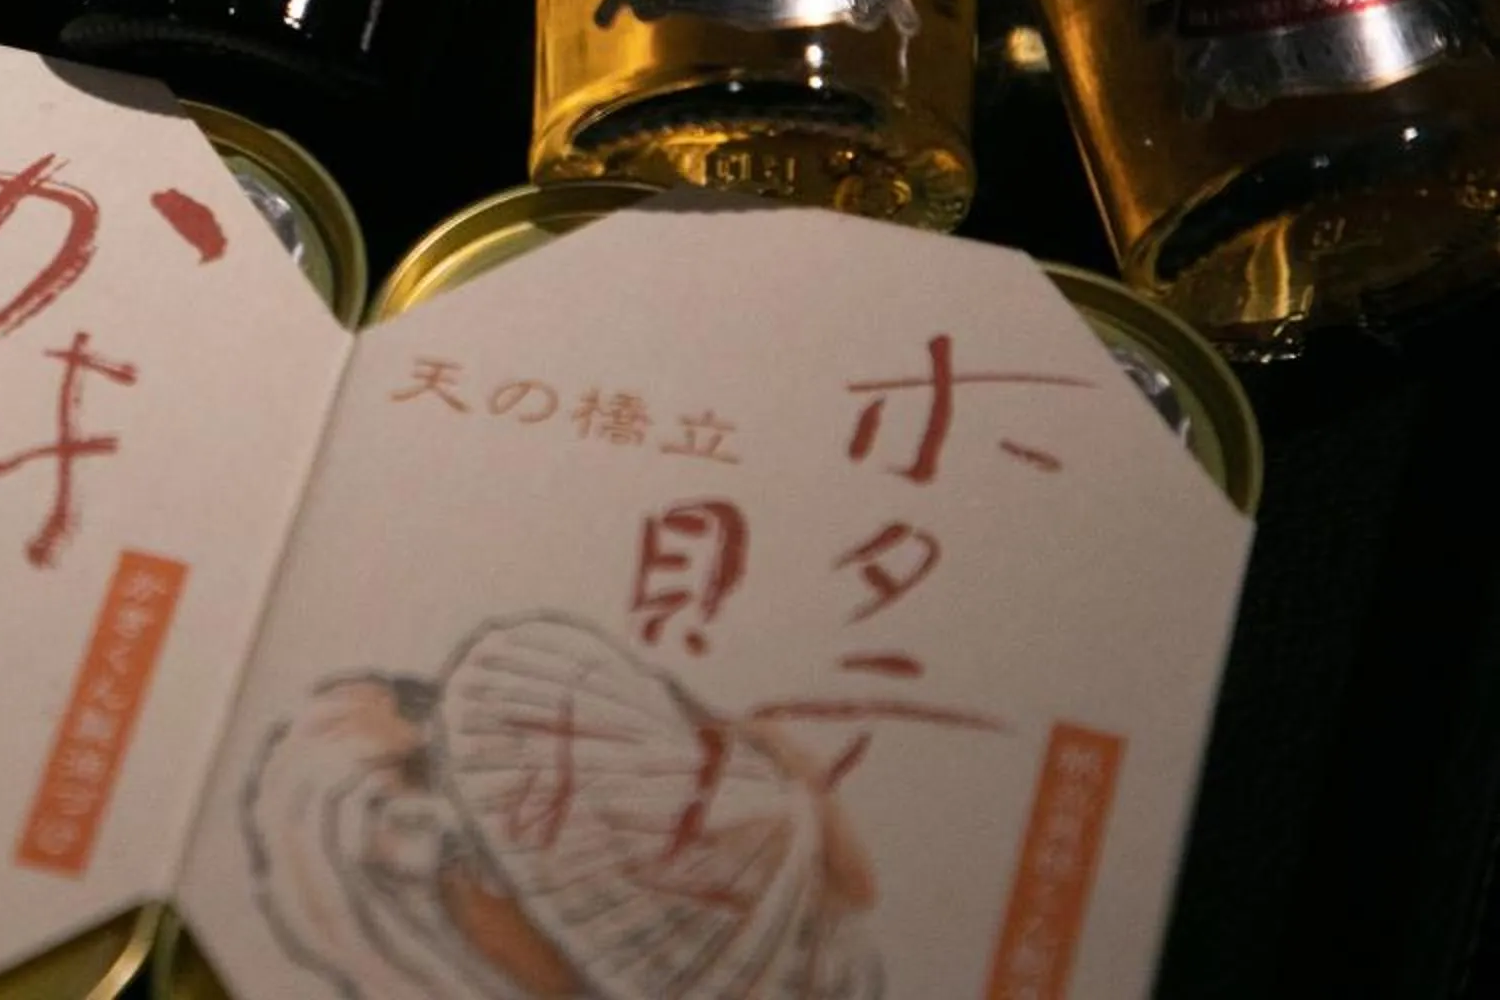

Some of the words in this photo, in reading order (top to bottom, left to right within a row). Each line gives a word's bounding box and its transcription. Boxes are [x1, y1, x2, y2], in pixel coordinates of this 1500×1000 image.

[389, 357, 744, 466] 天の橋立
[746, 333, 1098, 792] ホタテ
